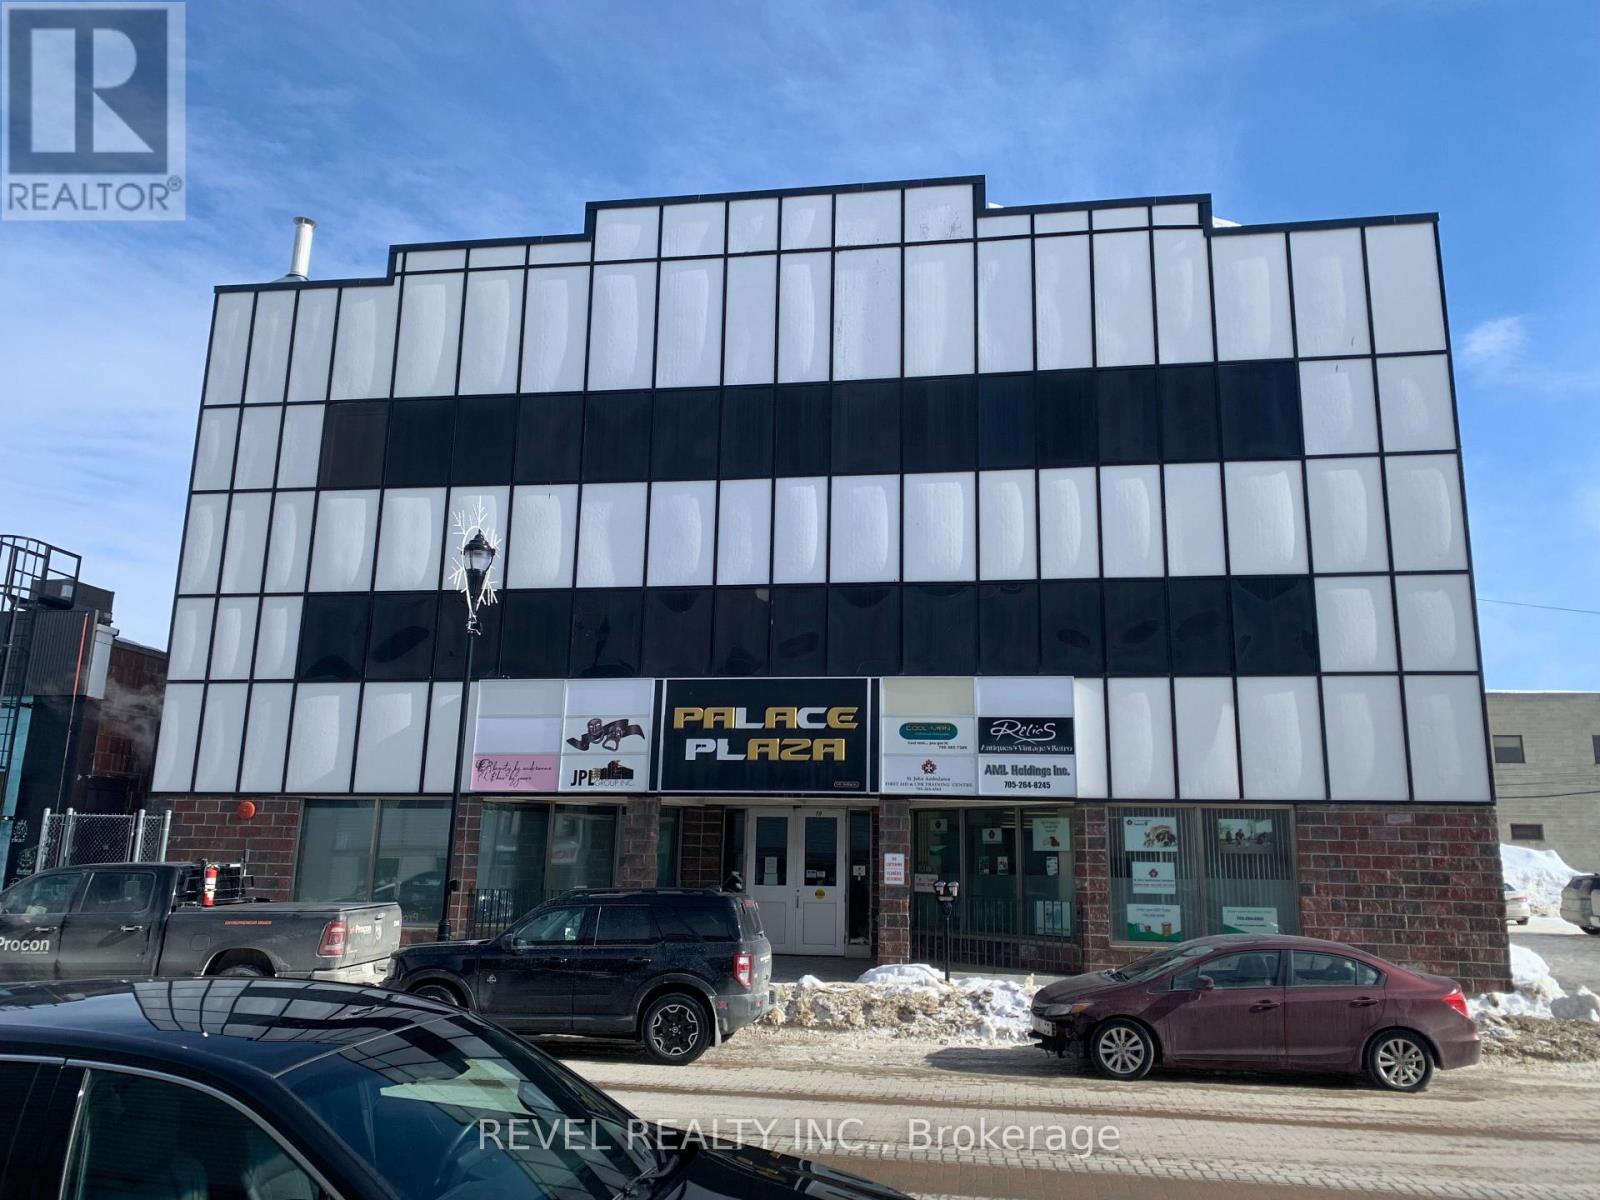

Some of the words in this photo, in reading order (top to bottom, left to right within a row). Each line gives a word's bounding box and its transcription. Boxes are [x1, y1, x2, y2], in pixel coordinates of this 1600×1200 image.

[673, 706, 859, 729] PALACE
[685, 738, 846, 761] PLAZA
[1018, 744, 1046, 753] Vintage
[1051, 744, 1073, 752] Retro
[570, 769, 594, 787] JPL
[984, 764, 1009, 776] AML
[1011, 764, 1052, 778] Holdings
[1053, 764, 1071, 777] Inc.
[1004, 780, 1051, 789] 705-264-8245
[0, 936, 50, 951] Procon
